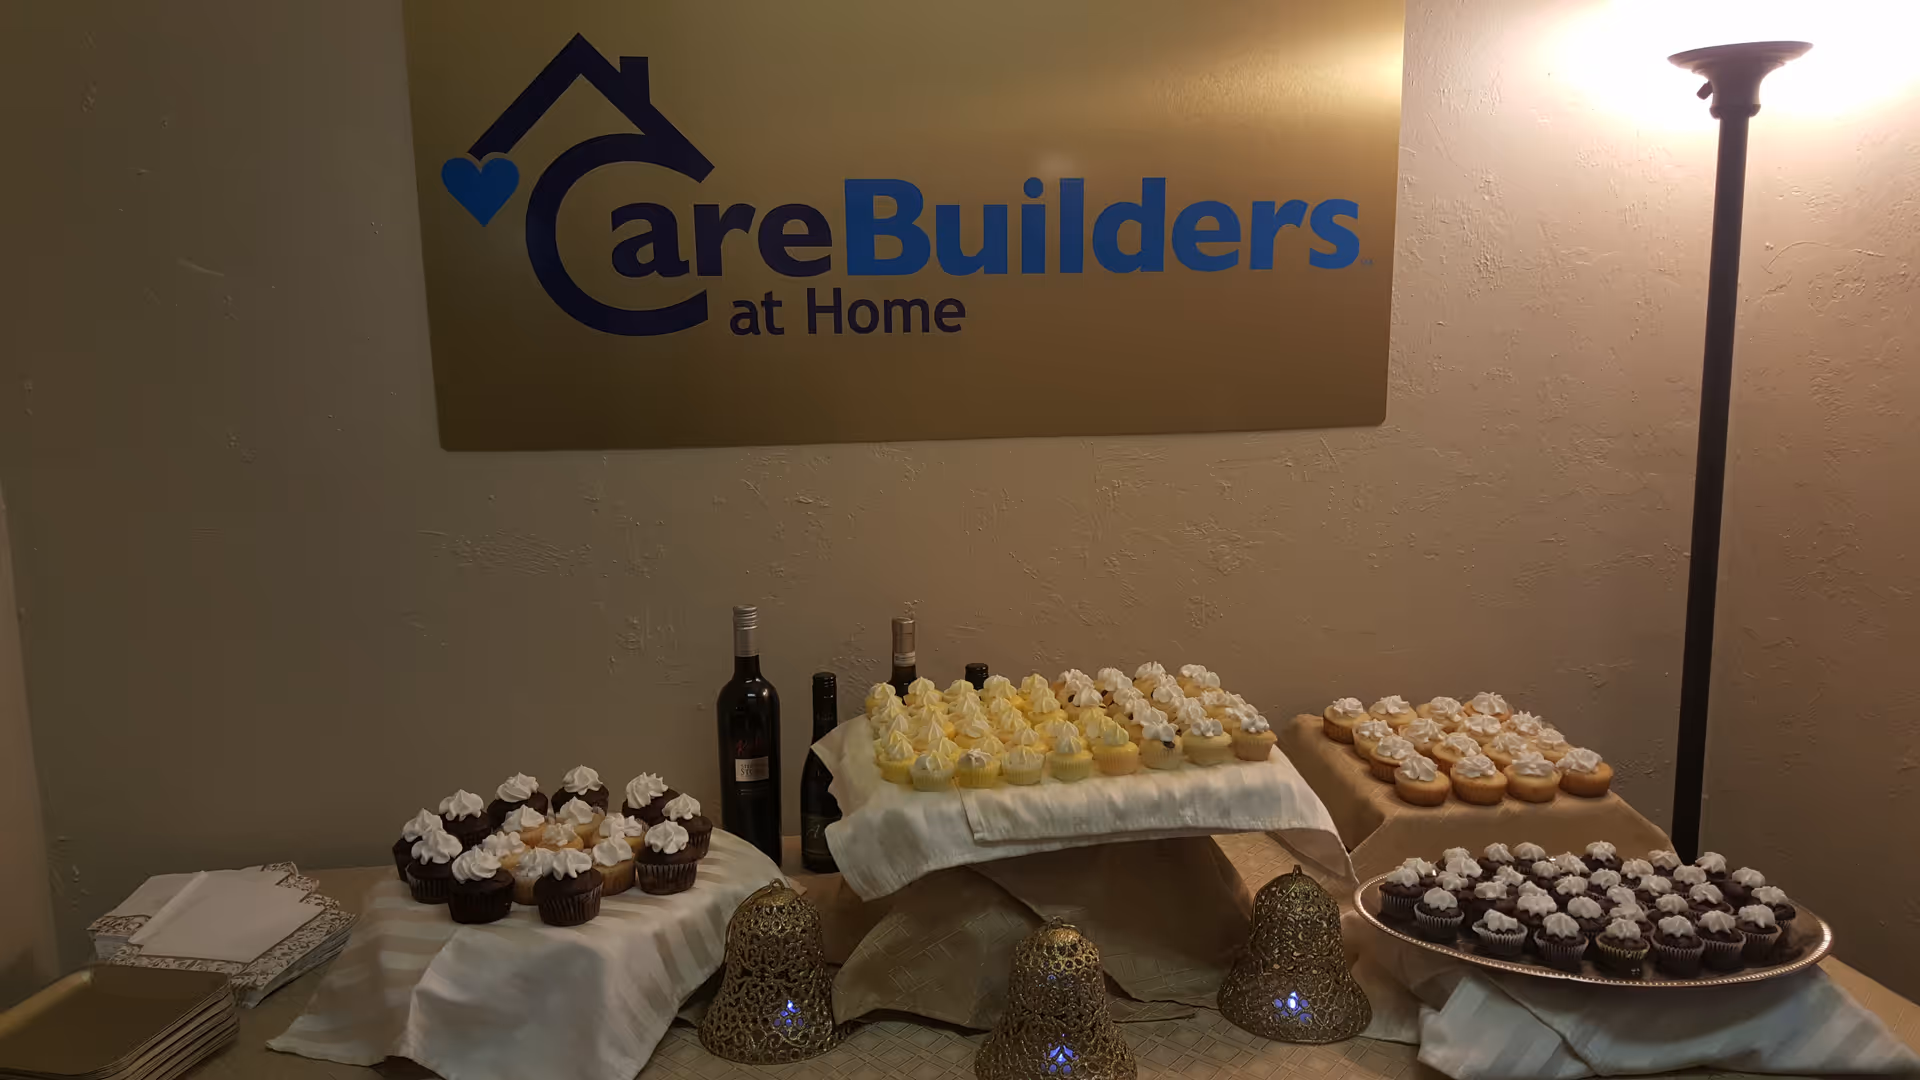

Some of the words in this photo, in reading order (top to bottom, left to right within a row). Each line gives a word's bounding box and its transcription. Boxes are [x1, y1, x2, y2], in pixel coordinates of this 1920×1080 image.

[525, 133, 1361, 337] CareBuilders
[730, 292, 785, 336] at
[806, 287, 966, 335] Home
